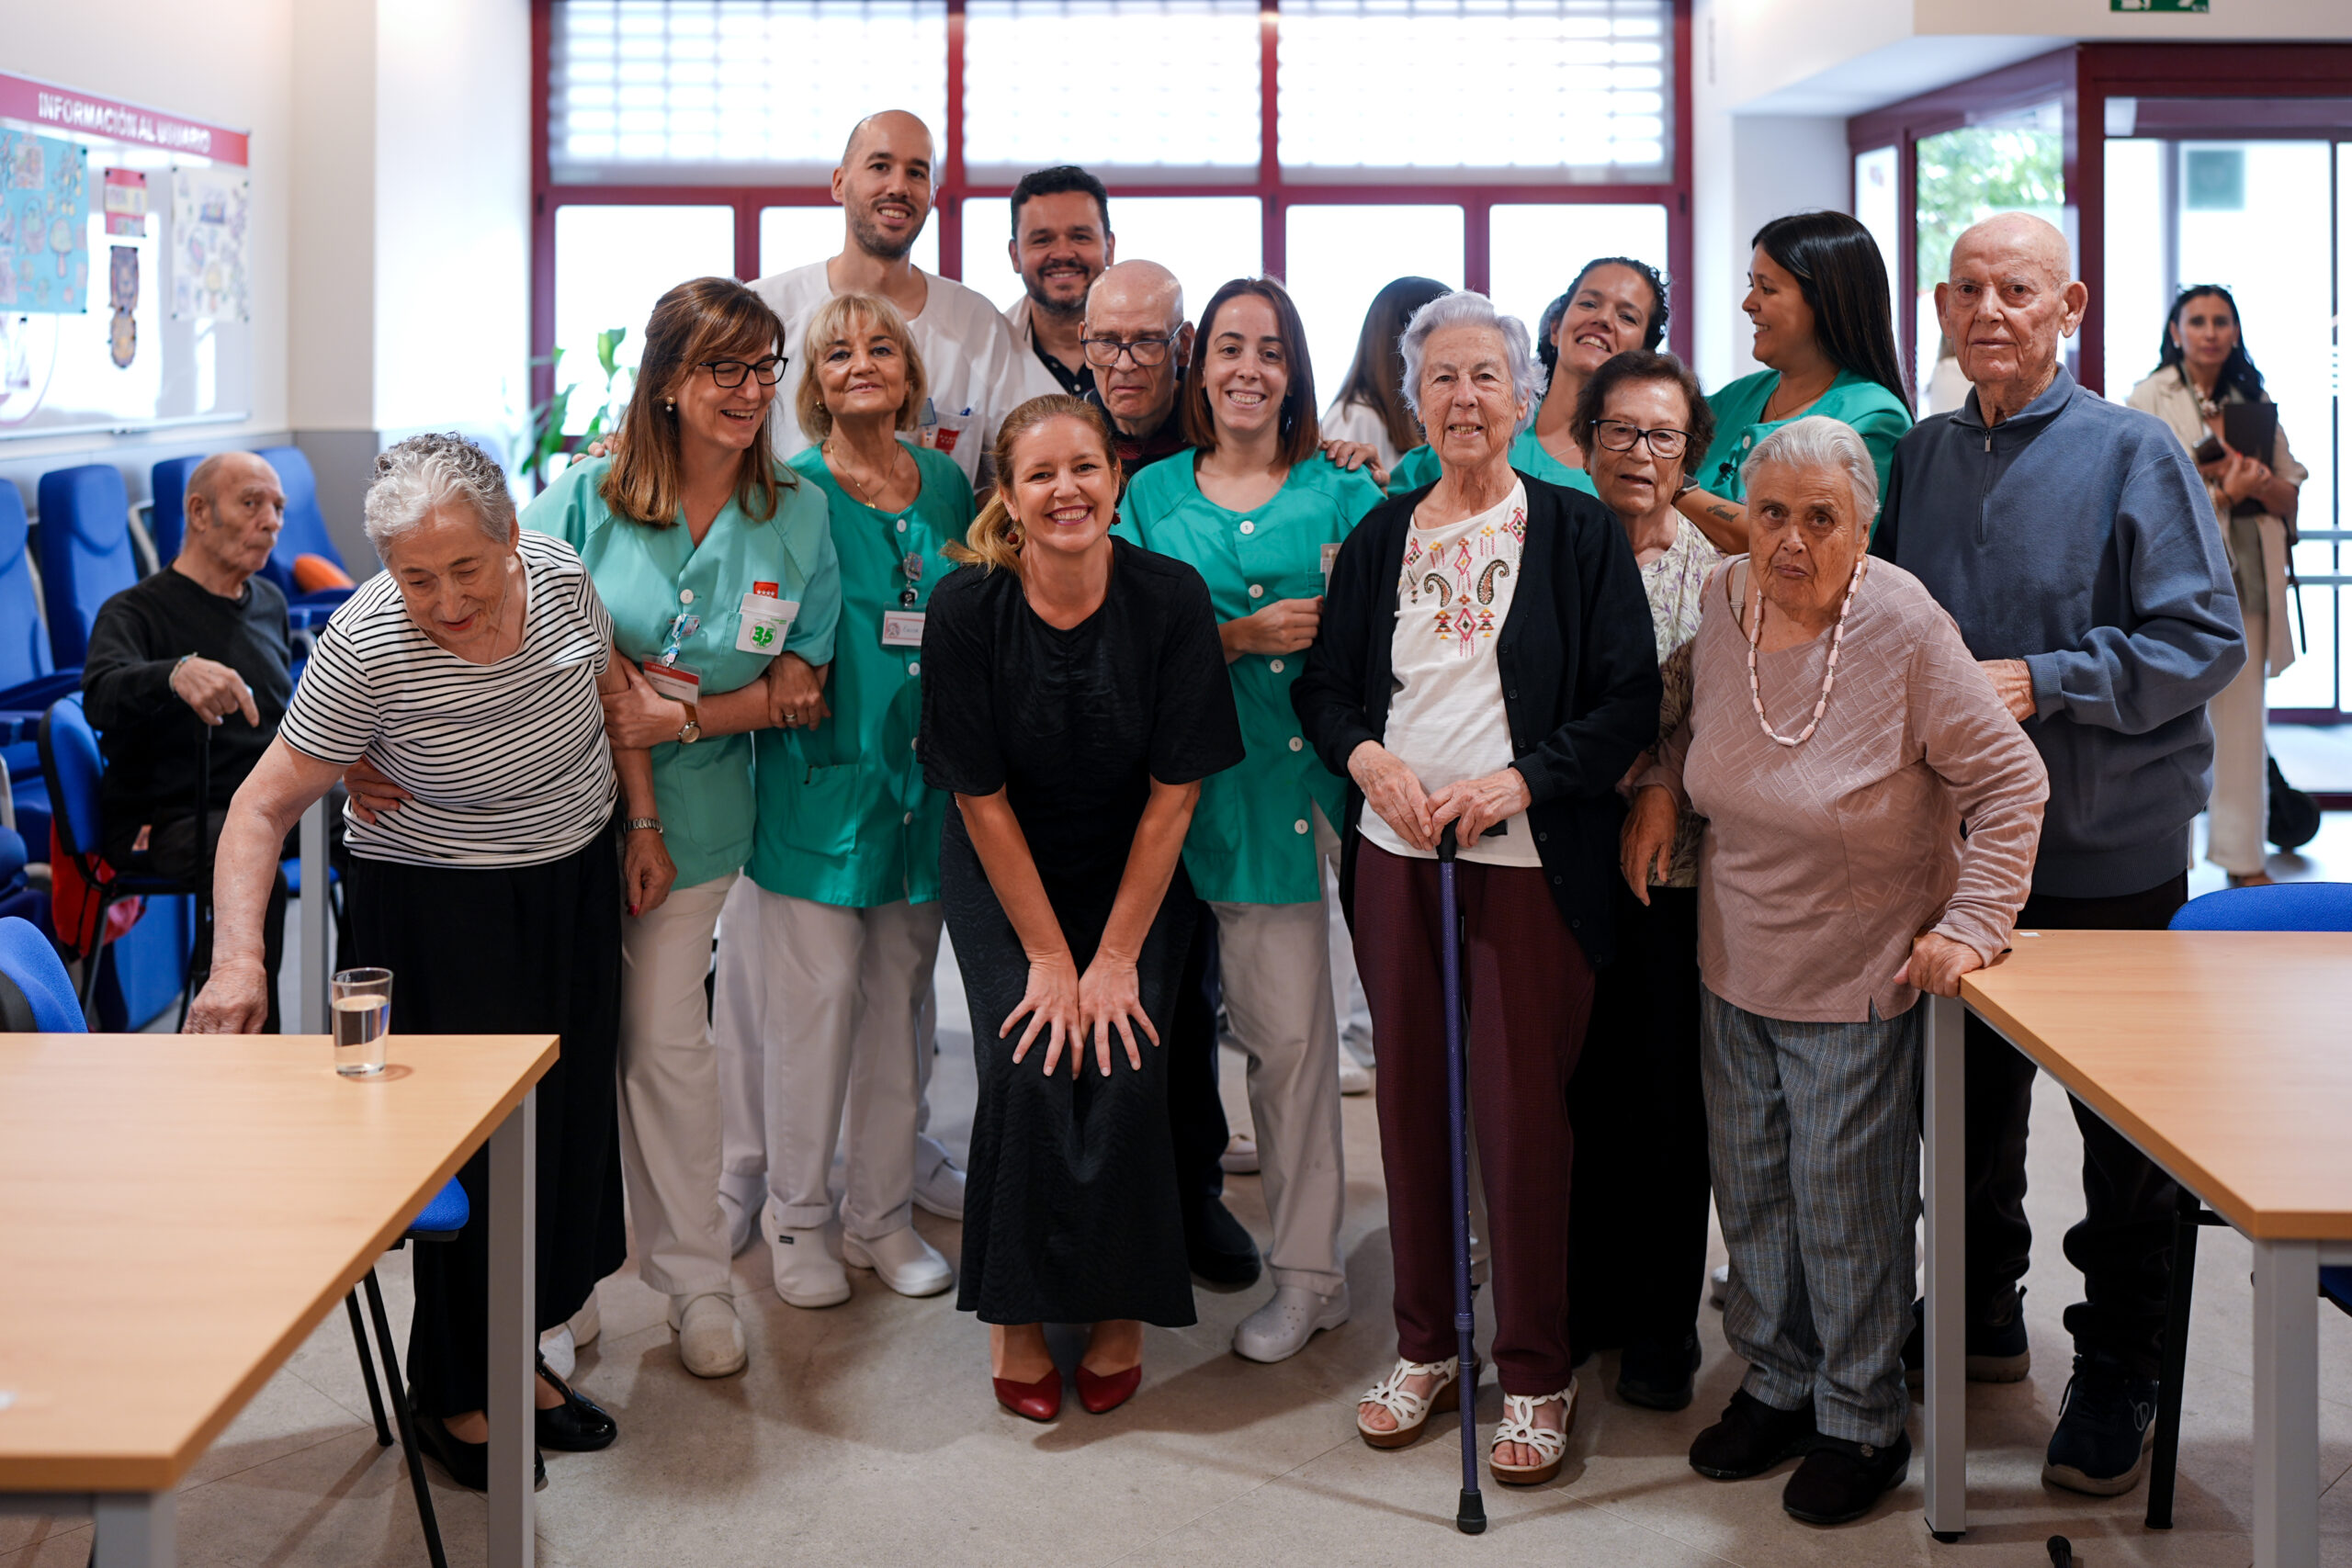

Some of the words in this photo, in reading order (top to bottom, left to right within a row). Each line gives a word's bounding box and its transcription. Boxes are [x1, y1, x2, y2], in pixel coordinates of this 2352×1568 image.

[39, 92, 137, 138] INFORMACIÓN
[138, 115, 156, 141] AL
[157, 120, 211, 153] USUARIO
[752, 626, 775, 644] 35
